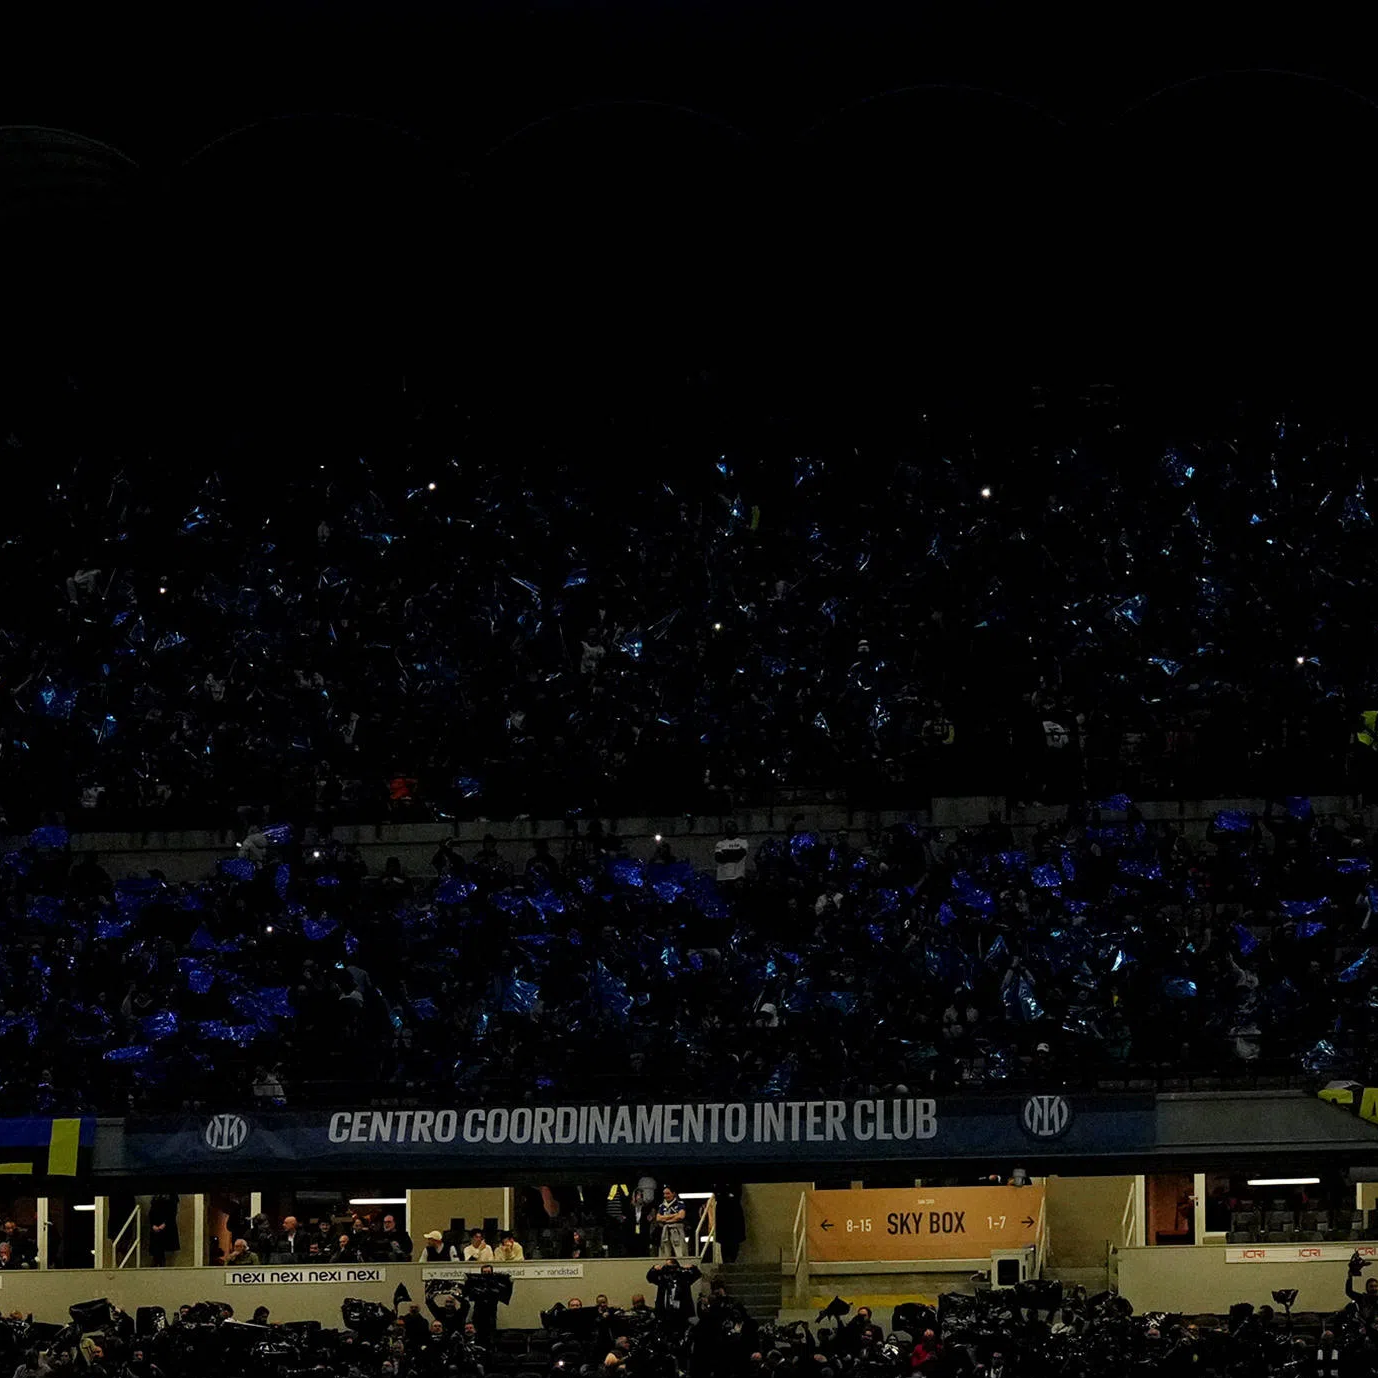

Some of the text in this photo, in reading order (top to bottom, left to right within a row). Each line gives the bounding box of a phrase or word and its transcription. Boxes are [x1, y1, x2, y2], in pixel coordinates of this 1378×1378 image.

[328, 1098, 938, 1144] CENTRO COORDINAMENTO INTER CLUB
[846, 1218, 872, 1233] 8-15
[887, 1211, 966, 1235] SKY BOX
[987, 1215, 1007, 1230] 1-7
[232, 1269, 380, 1284] nexi nexi nexi nexi
[546, 1267, 579, 1276] randstad
